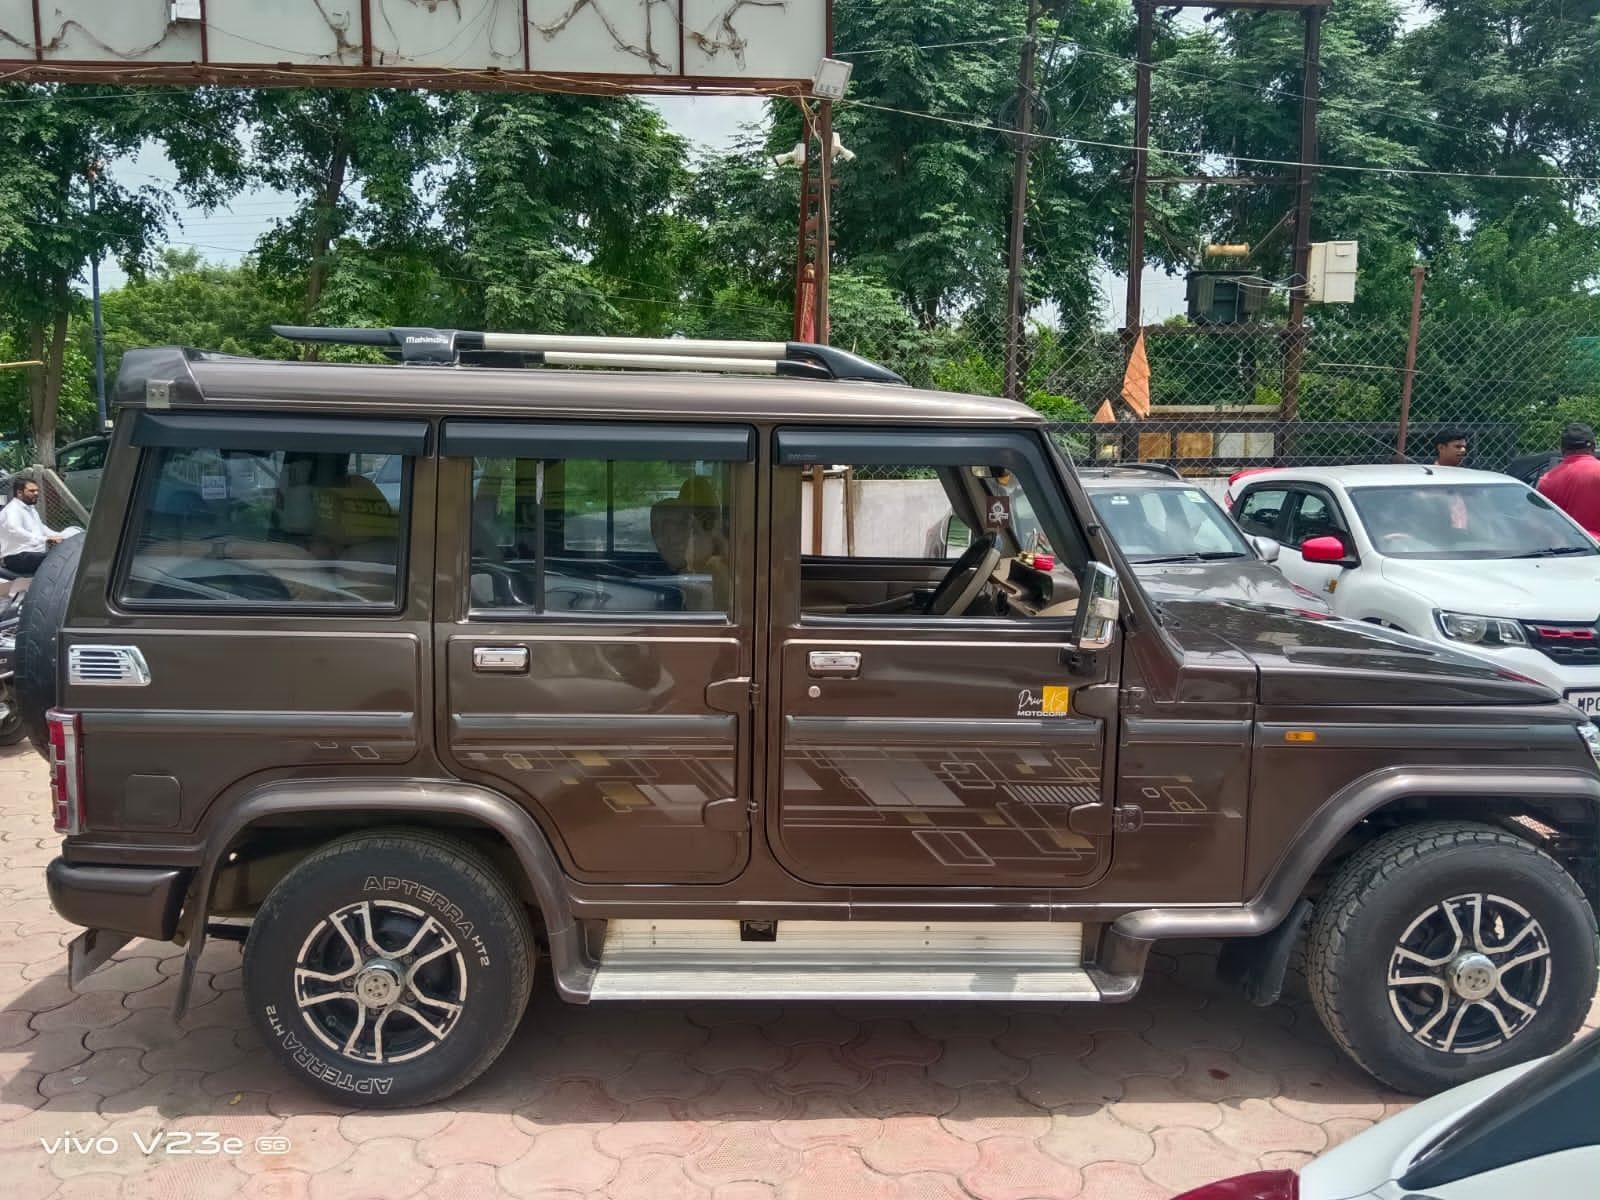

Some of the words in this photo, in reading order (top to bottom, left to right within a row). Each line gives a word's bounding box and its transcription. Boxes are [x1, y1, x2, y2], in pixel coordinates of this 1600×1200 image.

[363, 875, 474, 940] APTERRA
[471, 935, 491, 968] HT2
[265, 1004, 285, 1037] HT2
[282, 1031, 394, 1095] APTERRA
